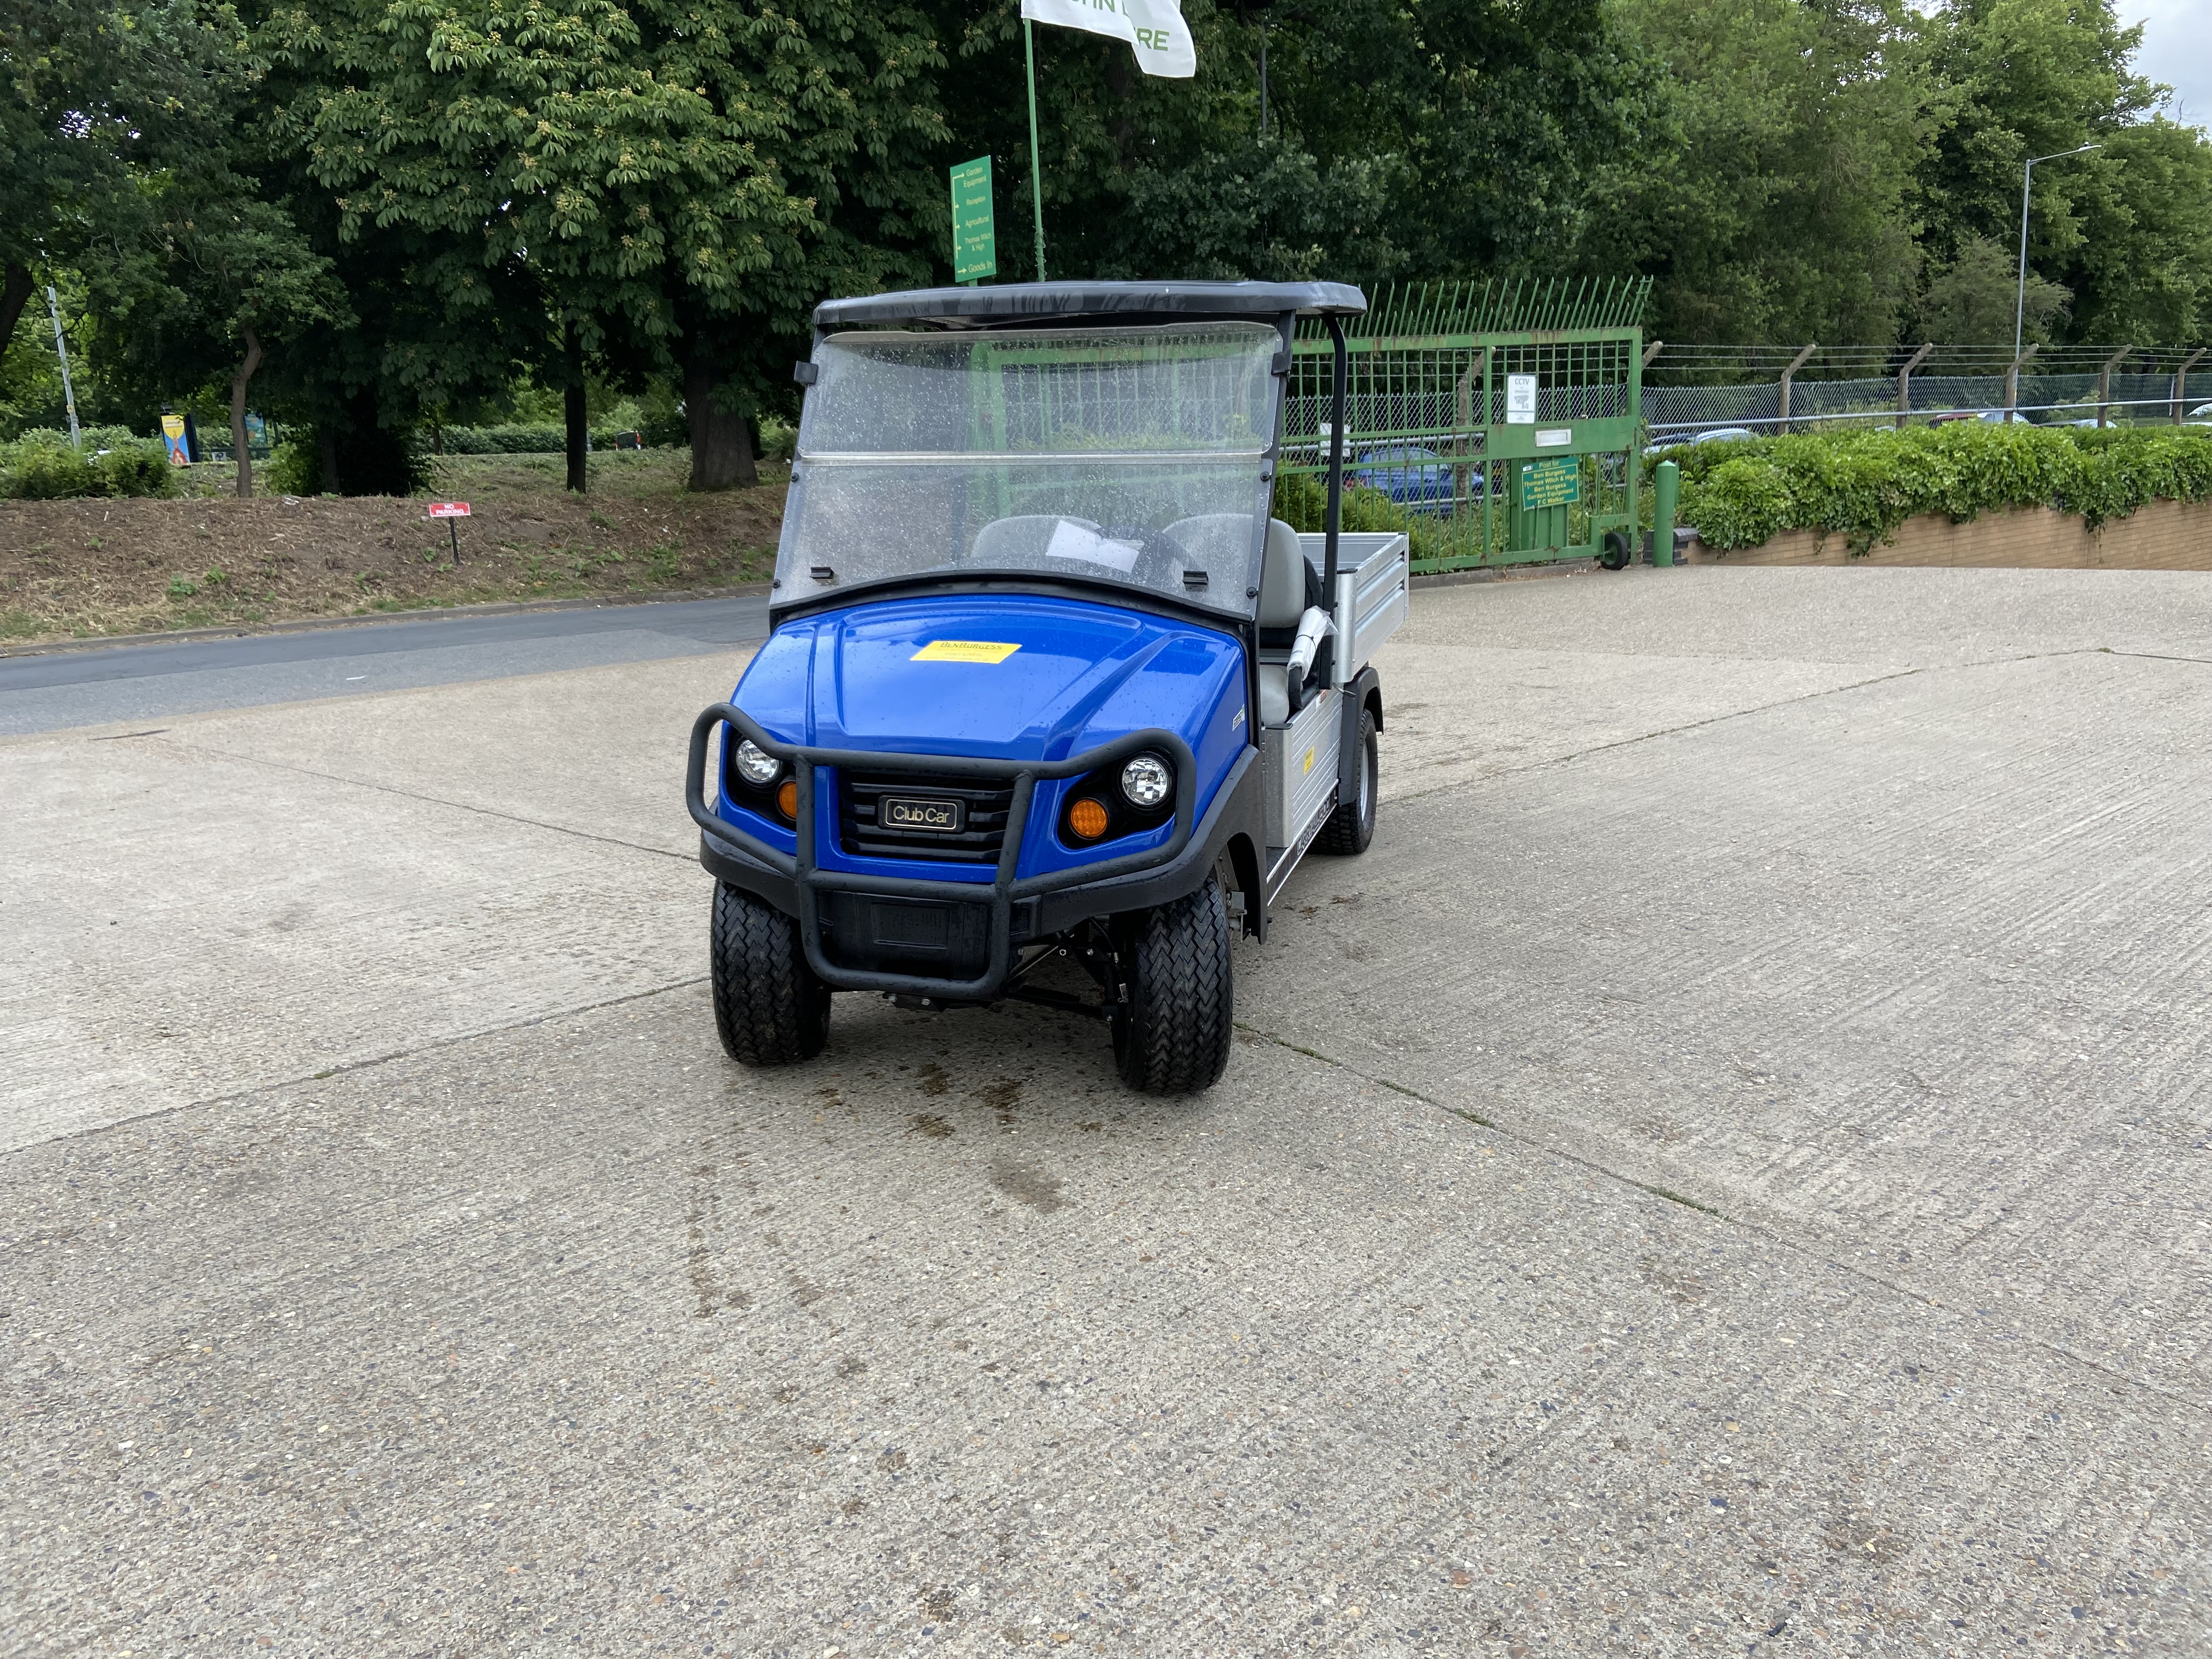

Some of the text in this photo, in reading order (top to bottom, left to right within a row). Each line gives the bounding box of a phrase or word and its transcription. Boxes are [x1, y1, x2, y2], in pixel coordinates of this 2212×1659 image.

[966, 166, 983, 177] Garden
[963, 174, 987, 188] Equipment
[966, 195, 986, 206] Reception
[965, 215, 990, 229] Agricultural
[975, 242, 985, 251] High
[968, 260, 992, 273] Goods In
[1547, 488, 1574, 497] Equipment
[893, 805, 950, 823] Club Car
